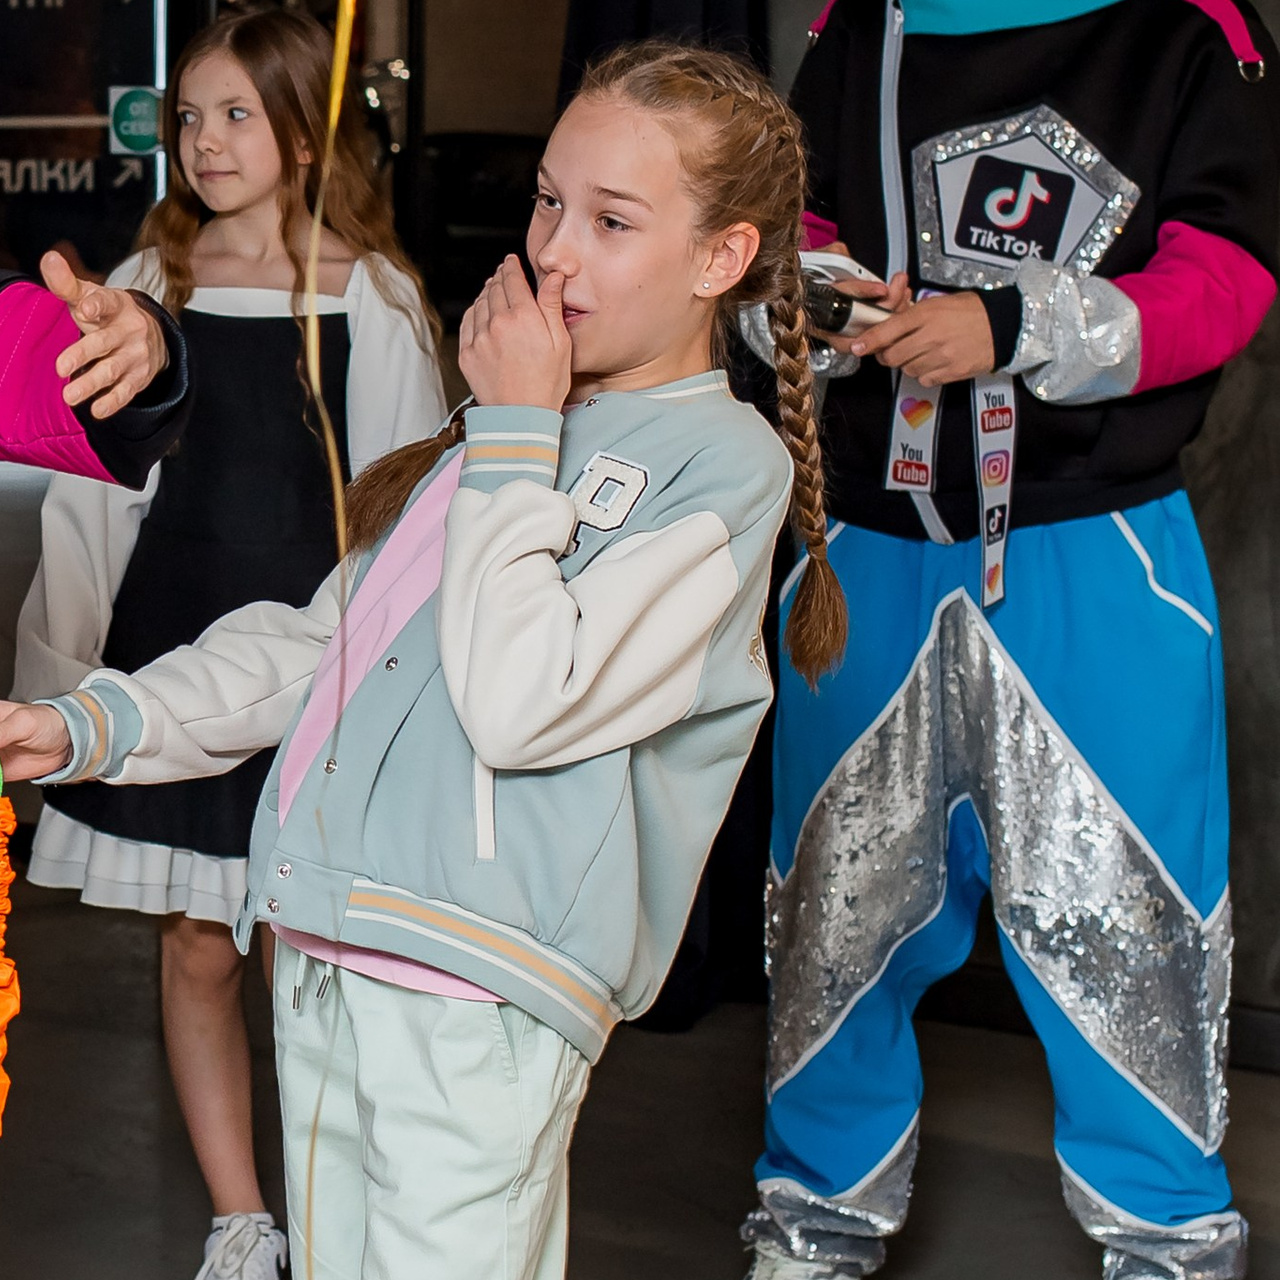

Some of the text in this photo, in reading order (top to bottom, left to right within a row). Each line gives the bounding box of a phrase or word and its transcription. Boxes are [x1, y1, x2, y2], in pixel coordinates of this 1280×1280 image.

[969, 226, 1044, 260] TikTok
[984, 392, 1005, 408] You
[983, 411, 1010, 430] Tube
[900, 442, 923, 462] You
[896, 463, 927, 483] Tube
